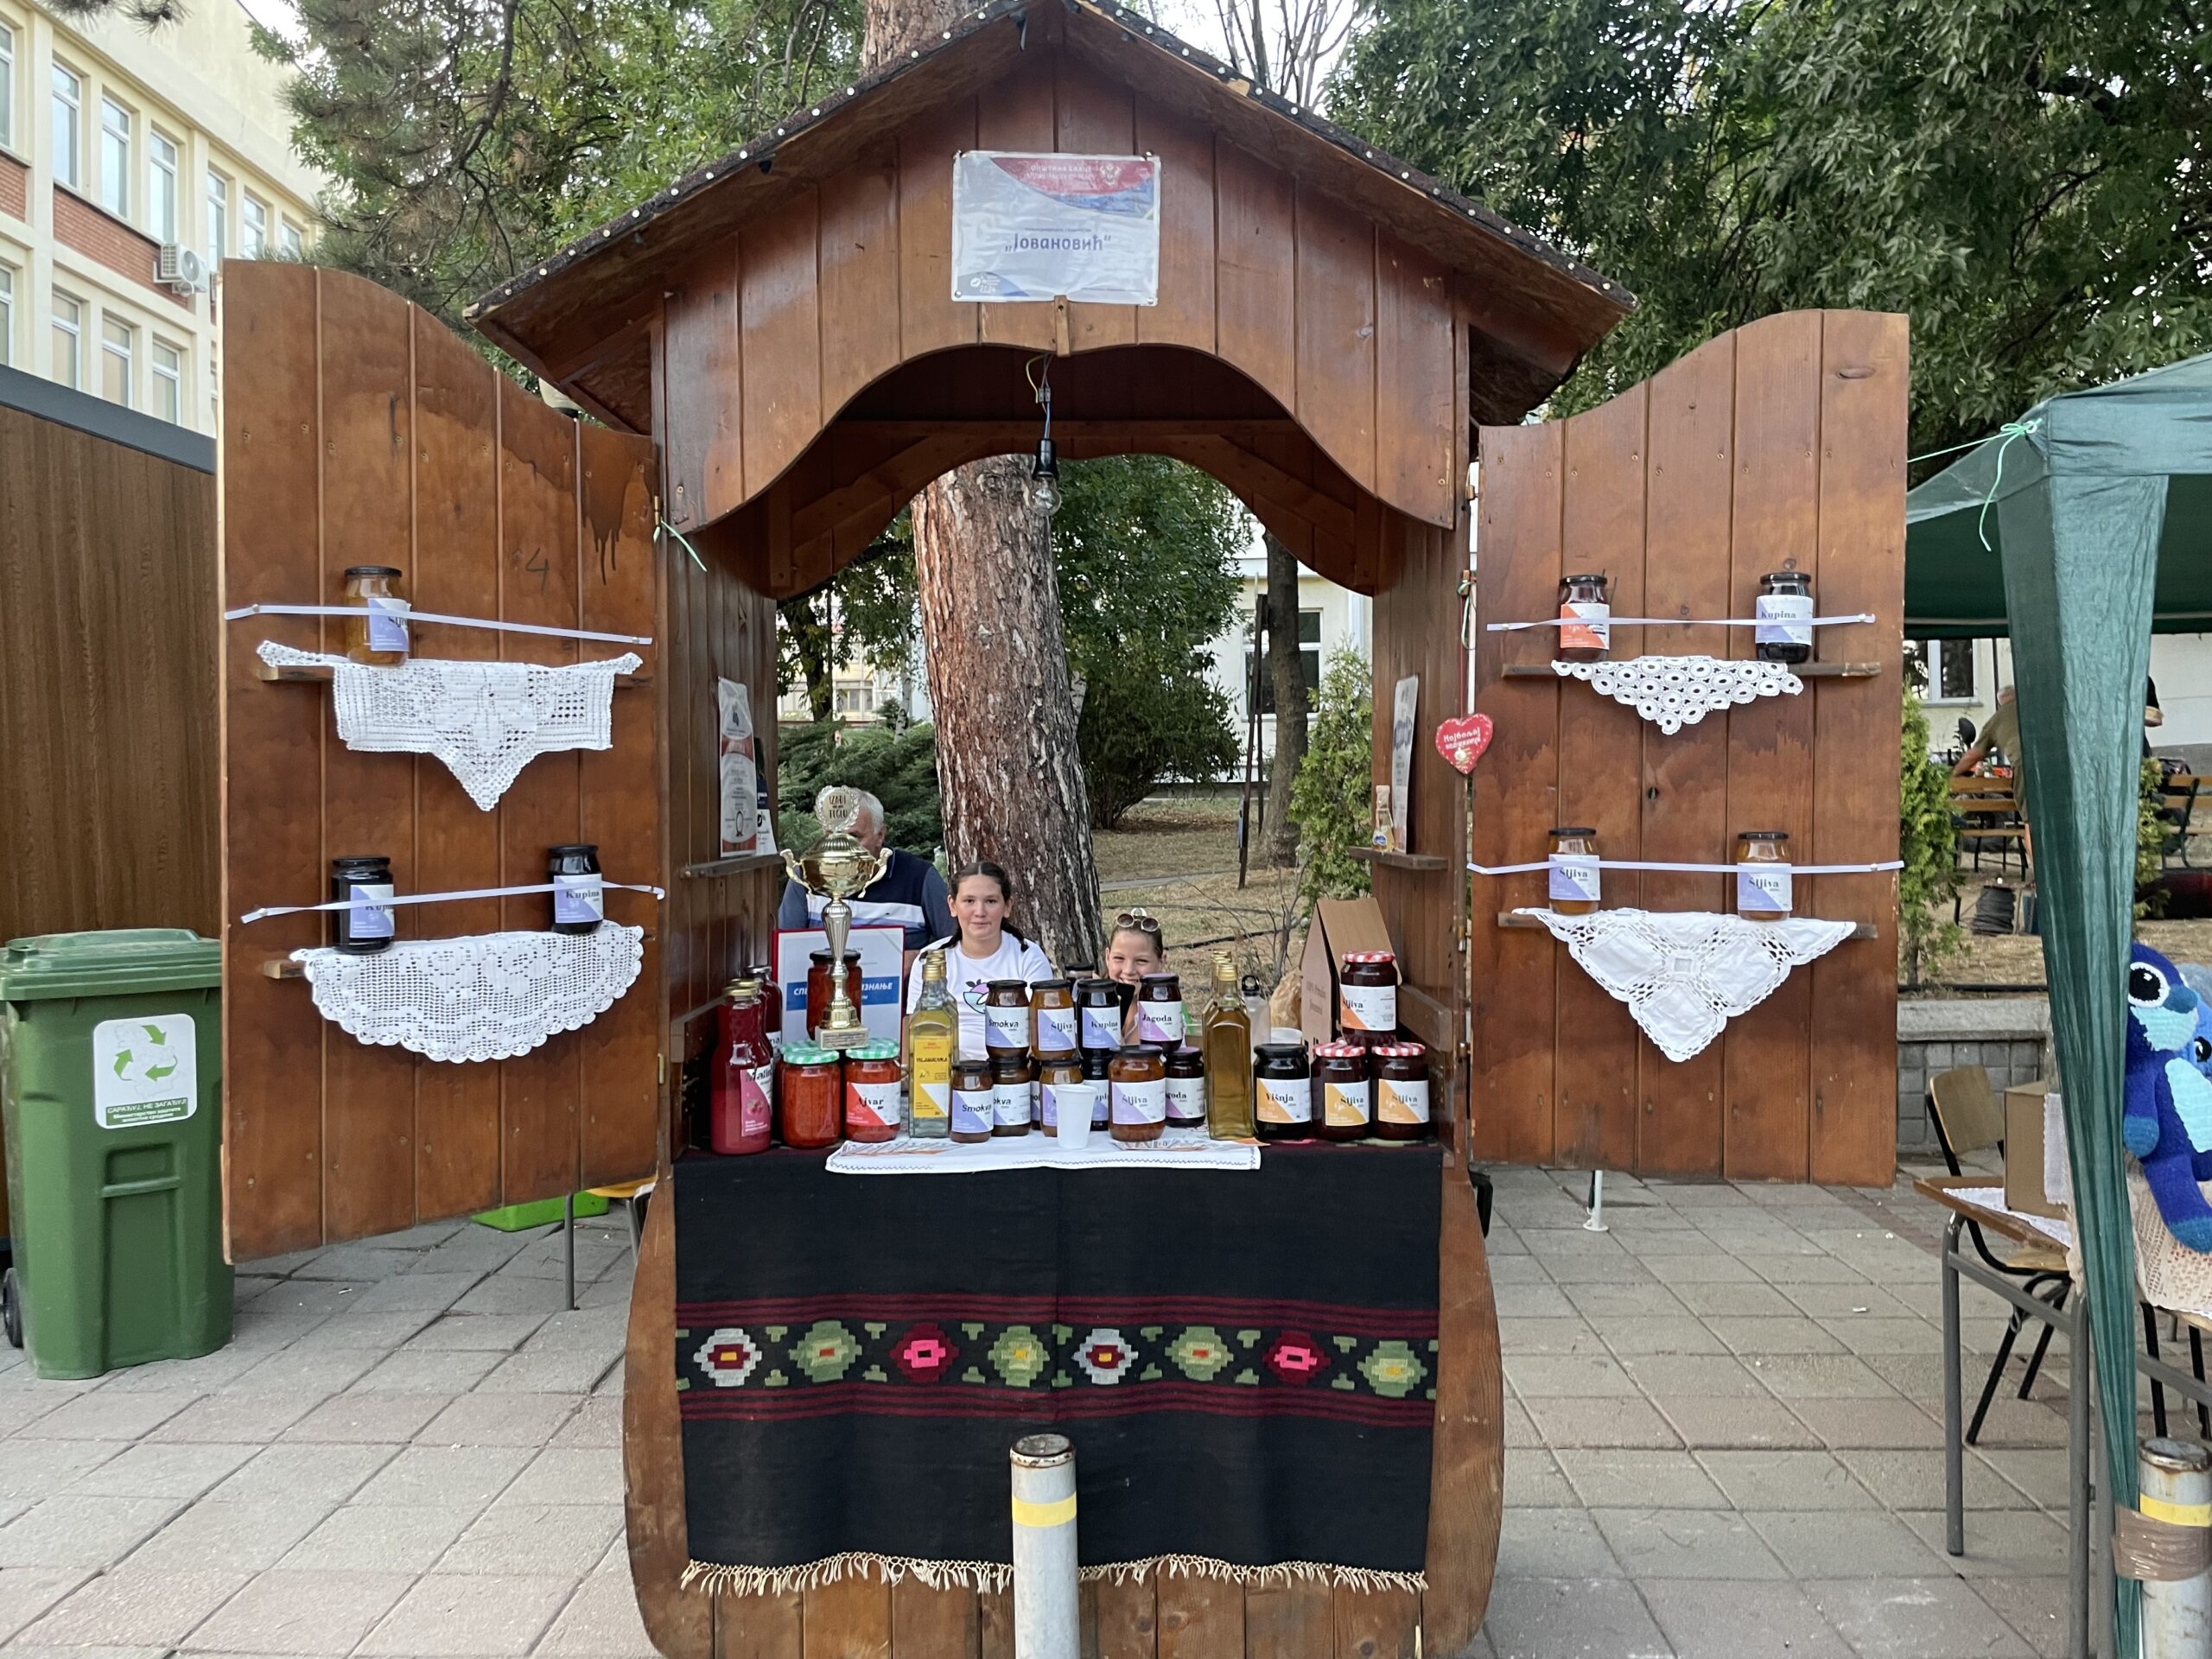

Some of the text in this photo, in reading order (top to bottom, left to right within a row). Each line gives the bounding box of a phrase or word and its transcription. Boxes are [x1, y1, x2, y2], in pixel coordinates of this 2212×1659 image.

[1761, 610, 1796, 620] Kupina
[1560, 867, 1588, 880] Šljiva
[1749, 876, 1779, 890] Šljiva
[566, 889, 600, 899] Kupina
[1141, 1014, 1173, 1022] Jagoda
[988, 1020, 1019, 1028] Smokva
[1051, 1021, 1072, 1032] Šljiva
[1090, 1020, 1118, 1029] Kupina
[1122, 1094, 1147, 1106] Šljiva
[1165, 1091, 1187, 1100] goda
[1265, 1092, 1294, 1103] Višnja
[1340, 1095, 1364, 1106] Šljiva
[1391, 1094, 1418, 1104] Šljiva
[962, 1103, 992, 1112] Smokva
